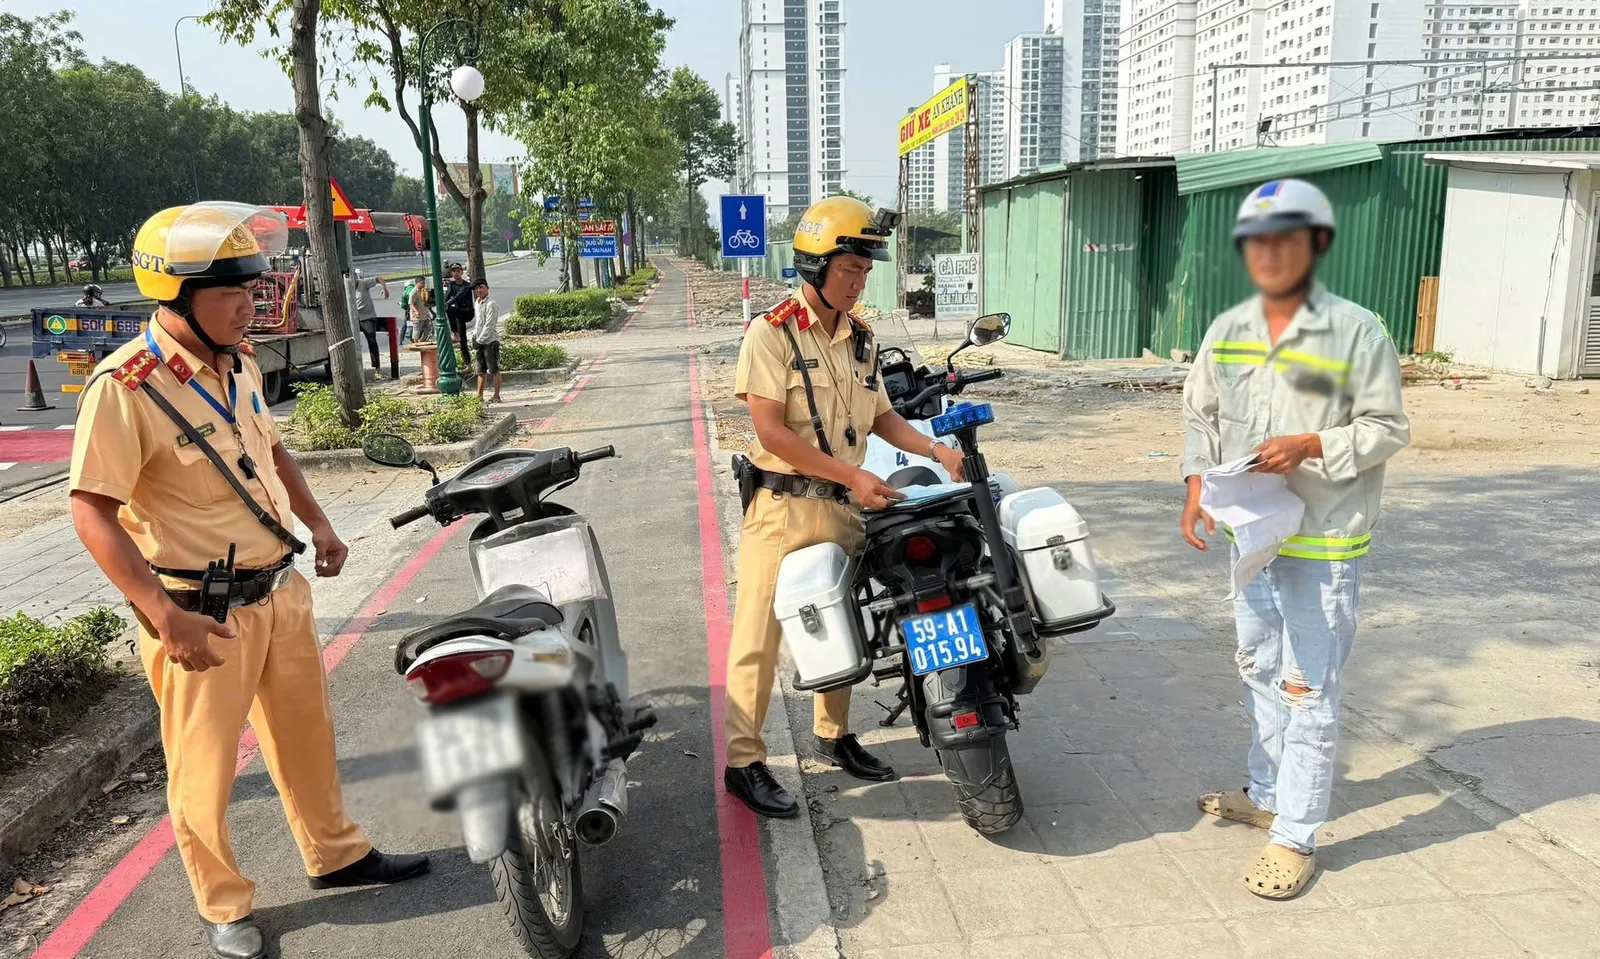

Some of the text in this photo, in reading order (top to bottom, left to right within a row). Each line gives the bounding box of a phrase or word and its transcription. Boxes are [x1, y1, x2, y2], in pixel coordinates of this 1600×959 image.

[900, 113, 916, 143] GIỮ
[918, 108, 931, 133] XE
[933, 102, 940, 120] AN
[941, 87, 963, 115] KHÁNH
[132, 249, 164, 273] SGT
[939, 256, 977, 275] CÀ PHÊ
[895, 451, 909, 467] 4
[912, 609, 969, 643] 59-A1
[914, 634, 981, 670] 015.94
